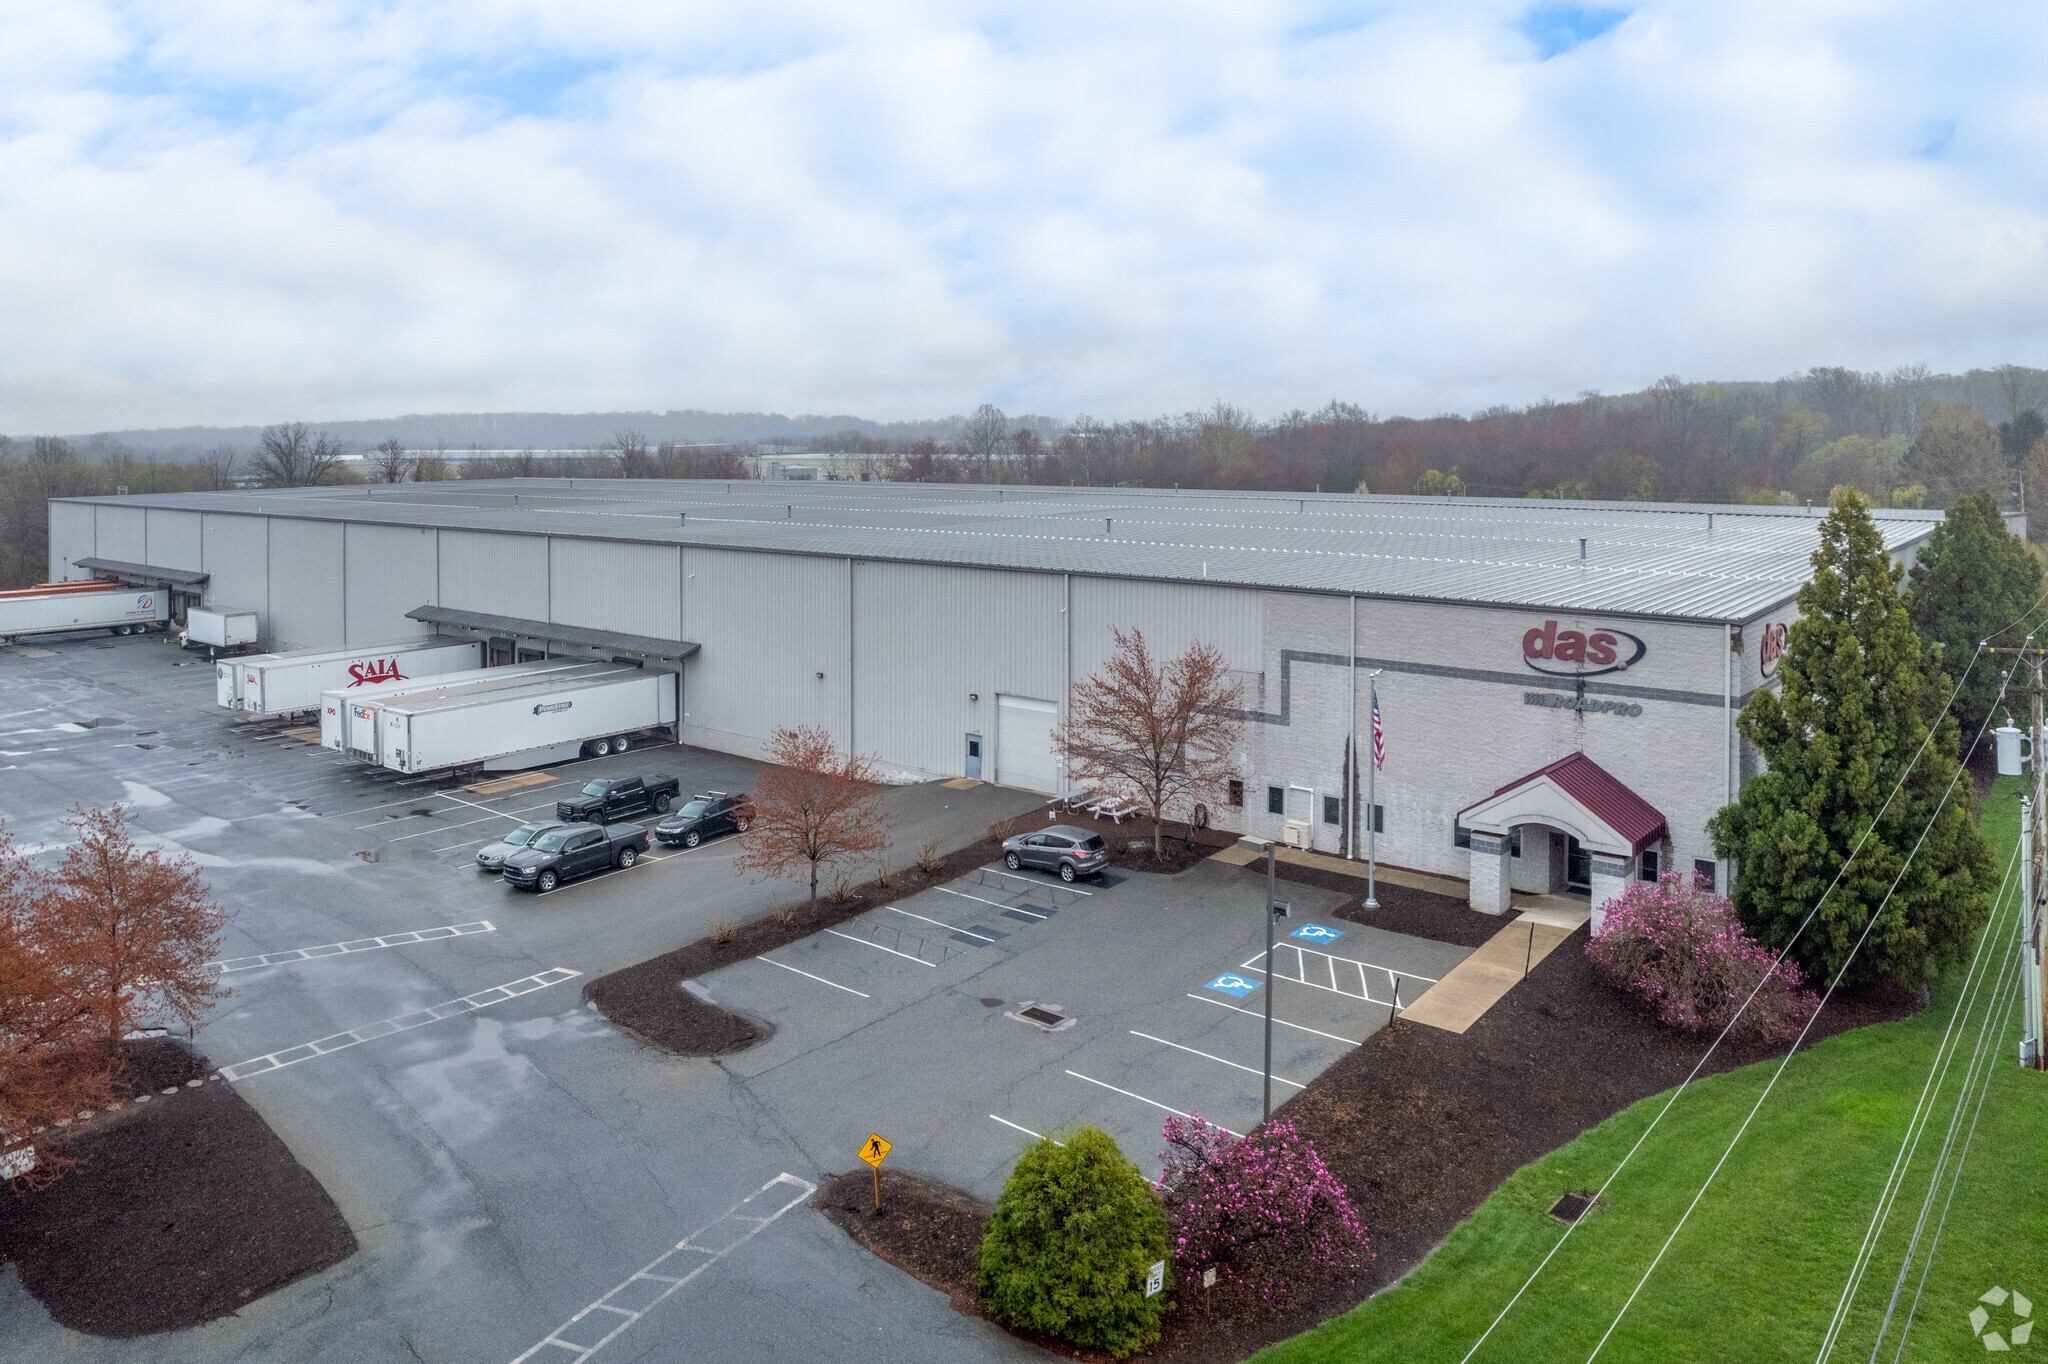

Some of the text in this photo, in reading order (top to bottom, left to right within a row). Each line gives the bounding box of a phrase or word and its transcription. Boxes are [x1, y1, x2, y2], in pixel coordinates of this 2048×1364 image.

[1522, 620, 1618, 665] das
[348, 659, 401, 686] SAIA
[354, 707, 371, 720] FedEx
[1544, 692, 1643, 717] ROADPRO
[1149, 1278, 1160, 1292] 15
